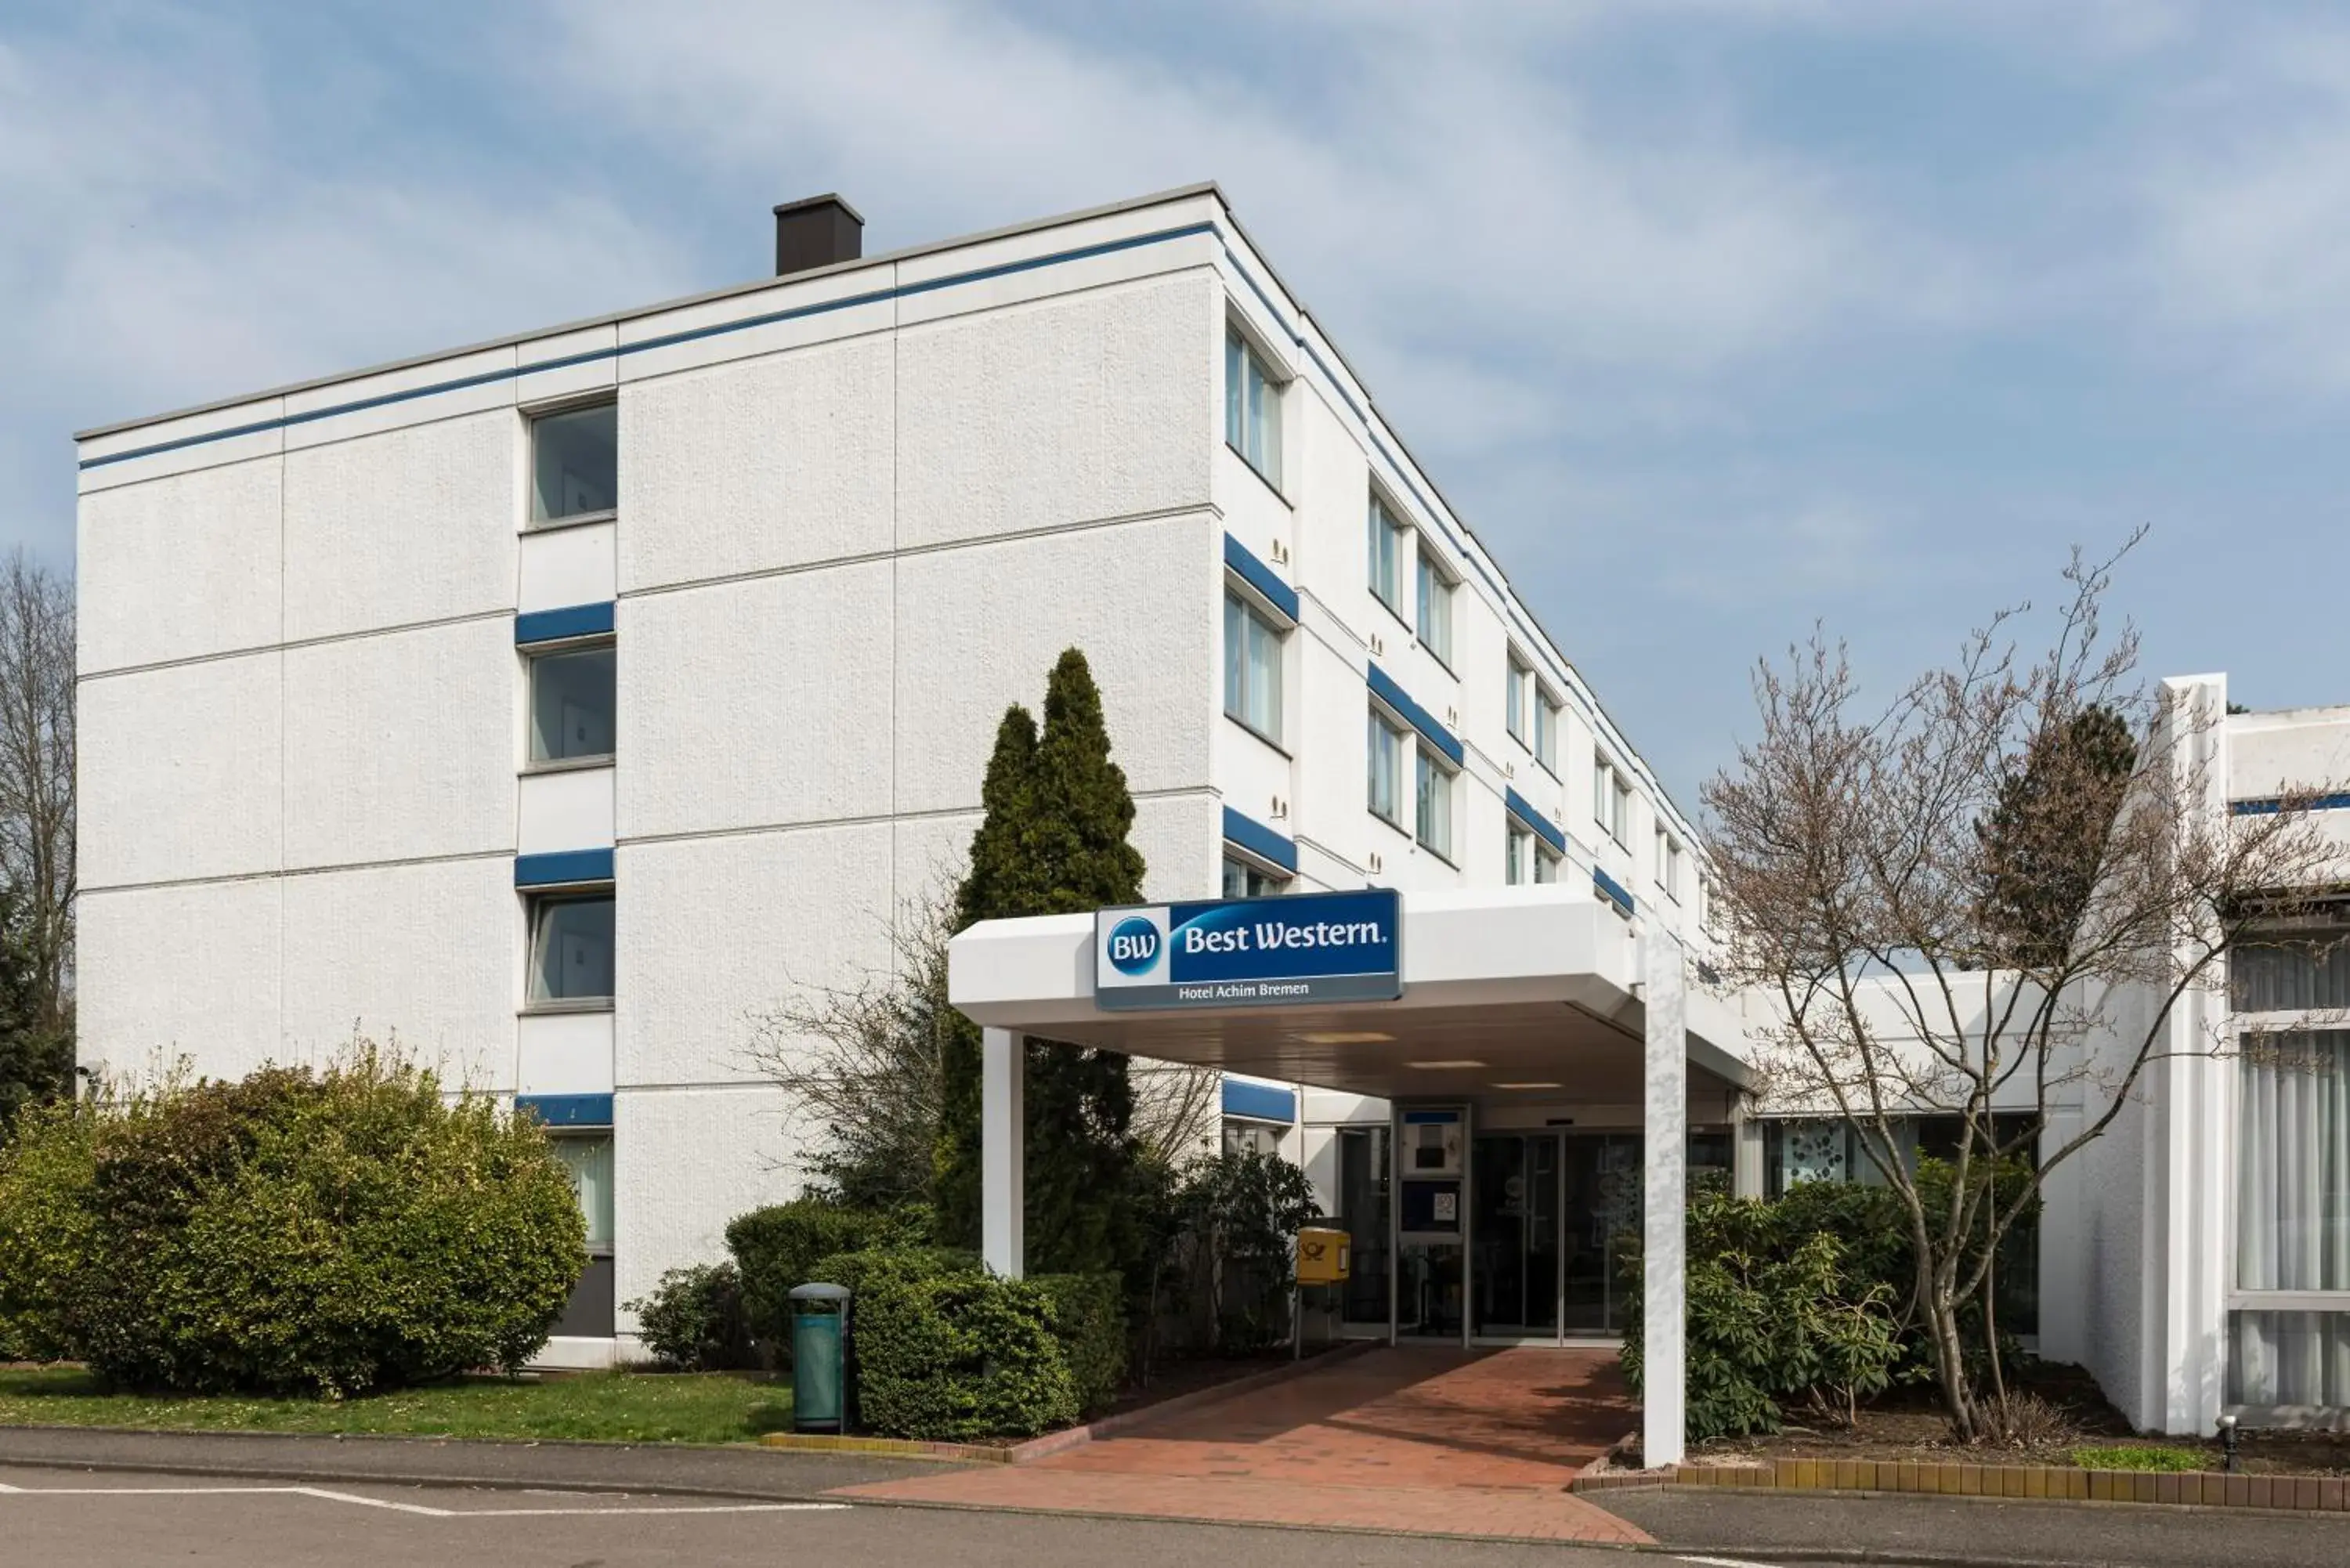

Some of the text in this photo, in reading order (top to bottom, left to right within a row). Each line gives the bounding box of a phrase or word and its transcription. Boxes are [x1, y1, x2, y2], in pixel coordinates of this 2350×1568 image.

[1114, 934, 1155, 959] BW
[1186, 927, 1249, 953] Best
[1179, 983, 1309, 999] Hotel Achim Bremen
